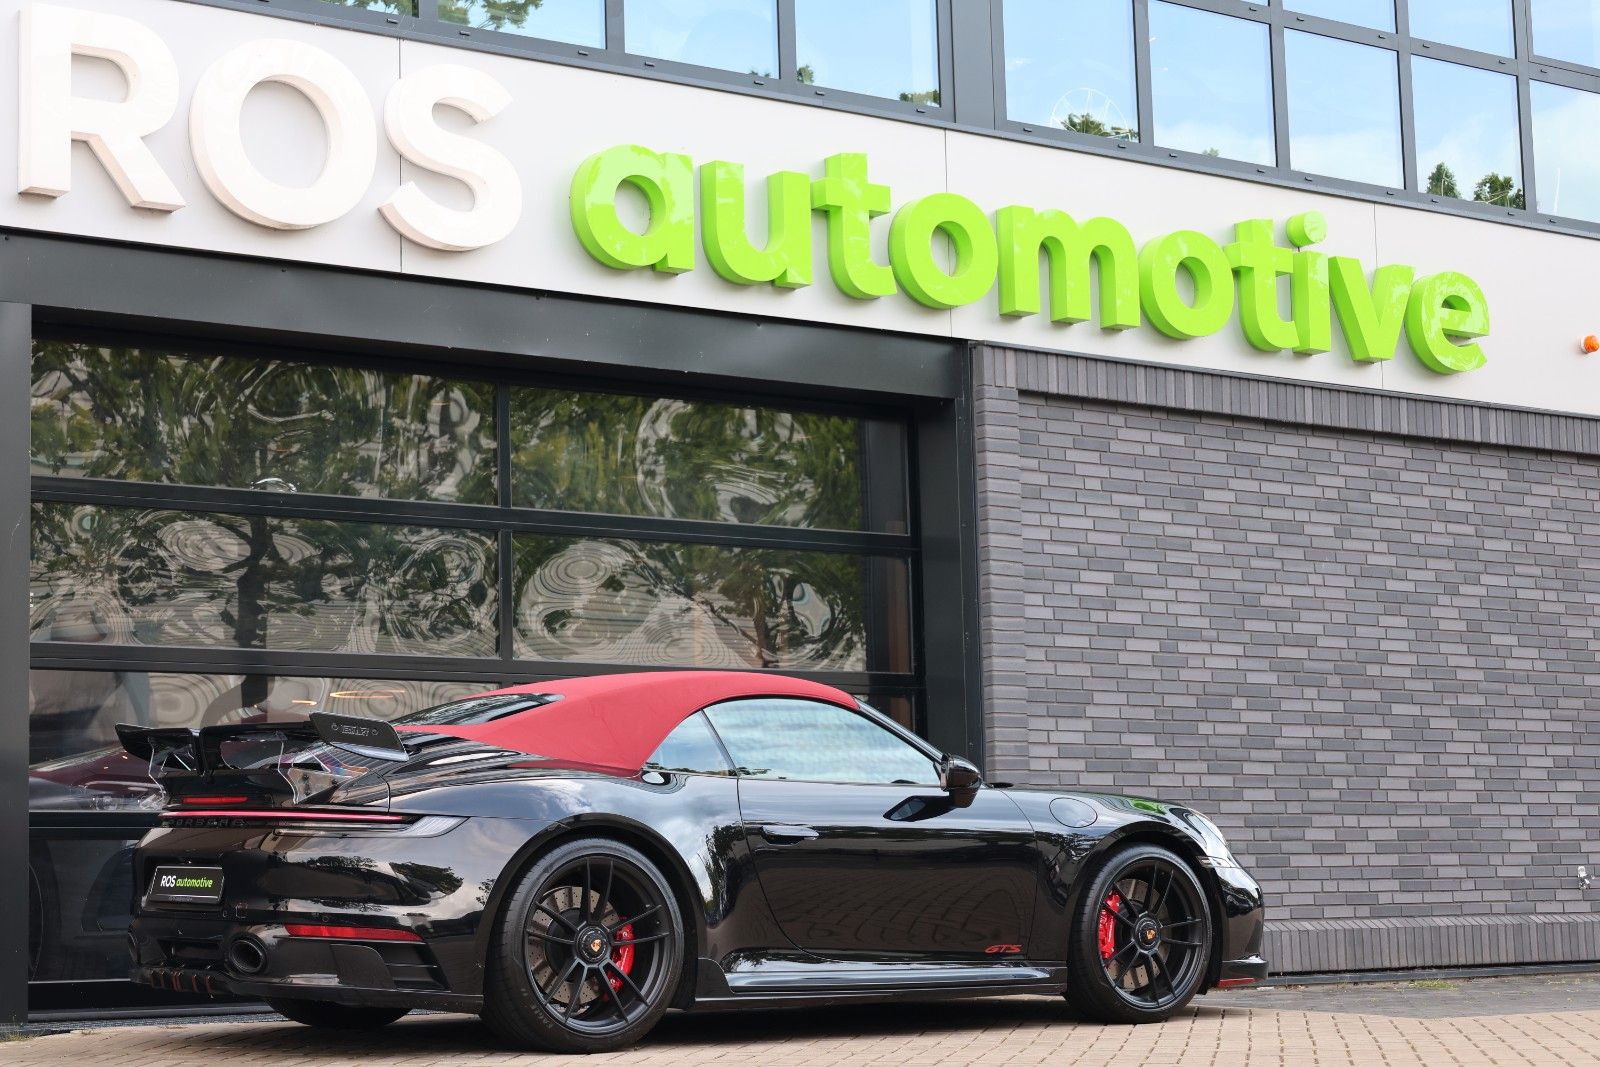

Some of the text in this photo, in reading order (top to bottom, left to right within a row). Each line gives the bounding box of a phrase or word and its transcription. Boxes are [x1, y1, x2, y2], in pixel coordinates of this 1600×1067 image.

[17, 3, 1490, 375] ROS automotive
[160, 875, 213, 888] ROS automotive
[985, 944, 1021, 953] GTS
